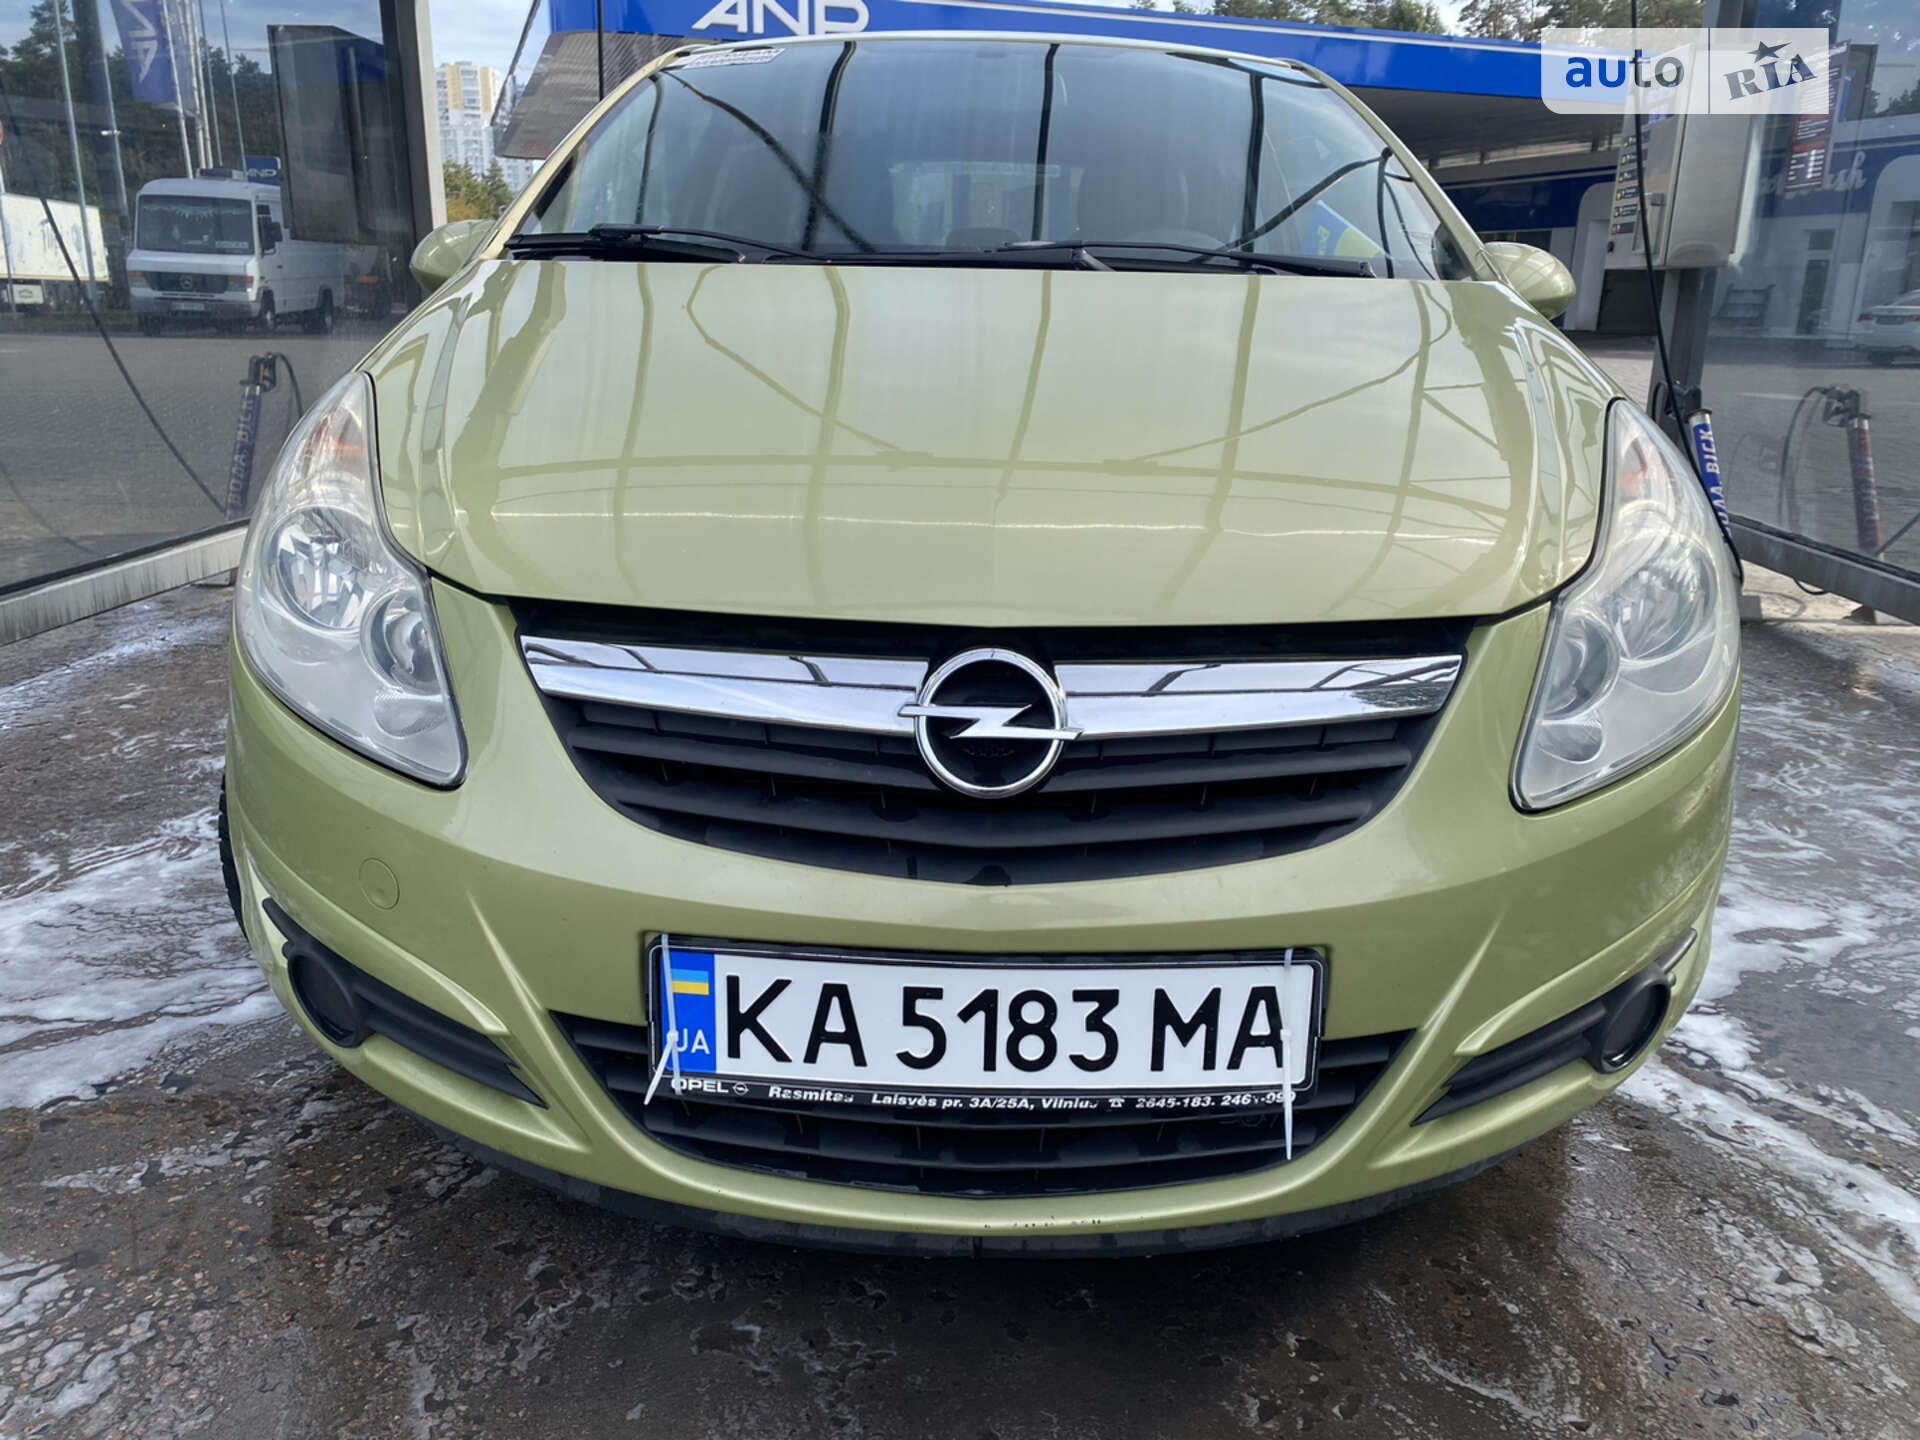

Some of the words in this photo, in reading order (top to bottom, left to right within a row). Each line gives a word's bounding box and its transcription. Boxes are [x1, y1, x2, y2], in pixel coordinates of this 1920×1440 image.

[726, 975, 868, 1067] KA
[896, 985, 1119, 1072] 5183
[1150, 985, 1284, 1071] MA
[671, 1078, 729, 1093] OPEL
[941, 1099, 963, 1109] pr.
[969, 1097, 1034, 1110] 3A/25A,
